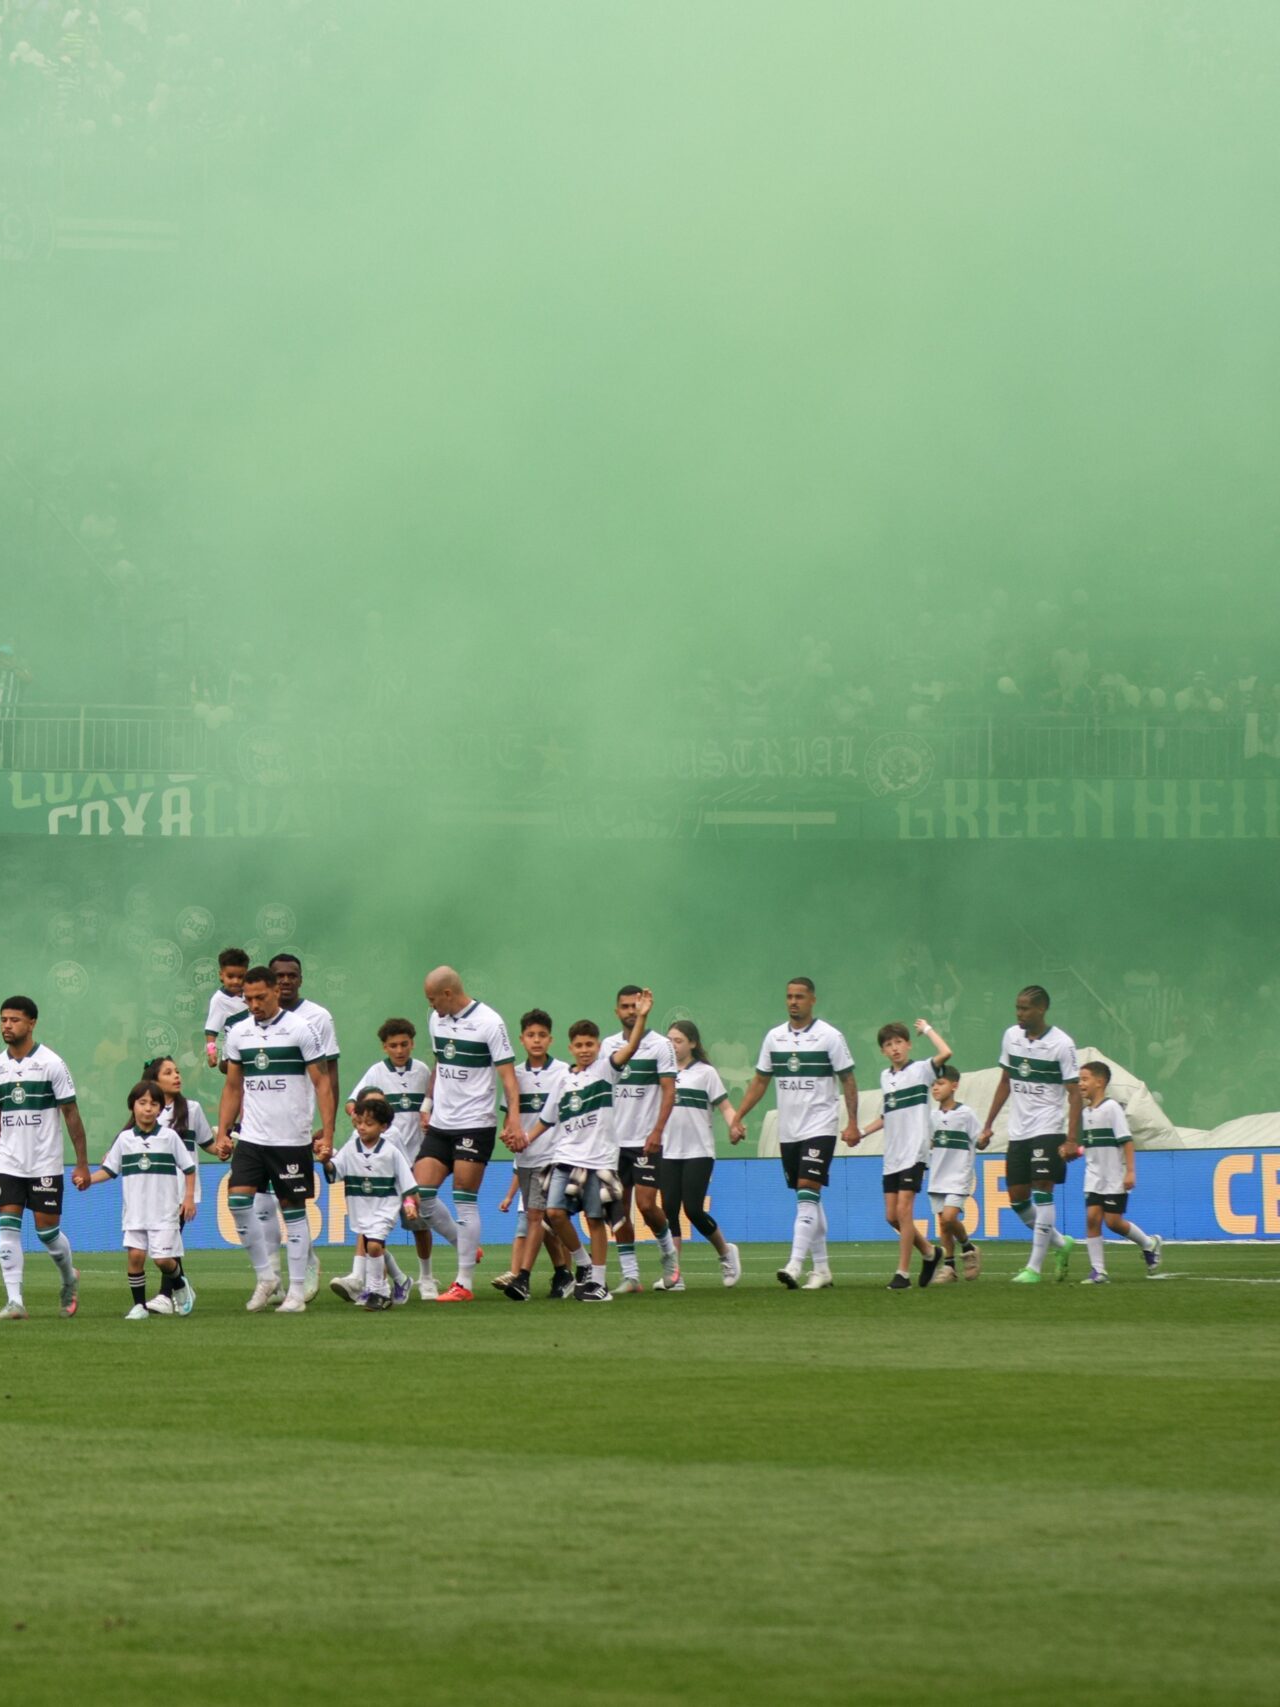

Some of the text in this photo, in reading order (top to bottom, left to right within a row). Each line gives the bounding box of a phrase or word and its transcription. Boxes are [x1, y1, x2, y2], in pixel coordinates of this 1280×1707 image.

[439, 1067, 469, 1080] EALS
[615, 1087, 646, 1098] EALS
[1014, 1083, 1045, 1095] EALS
